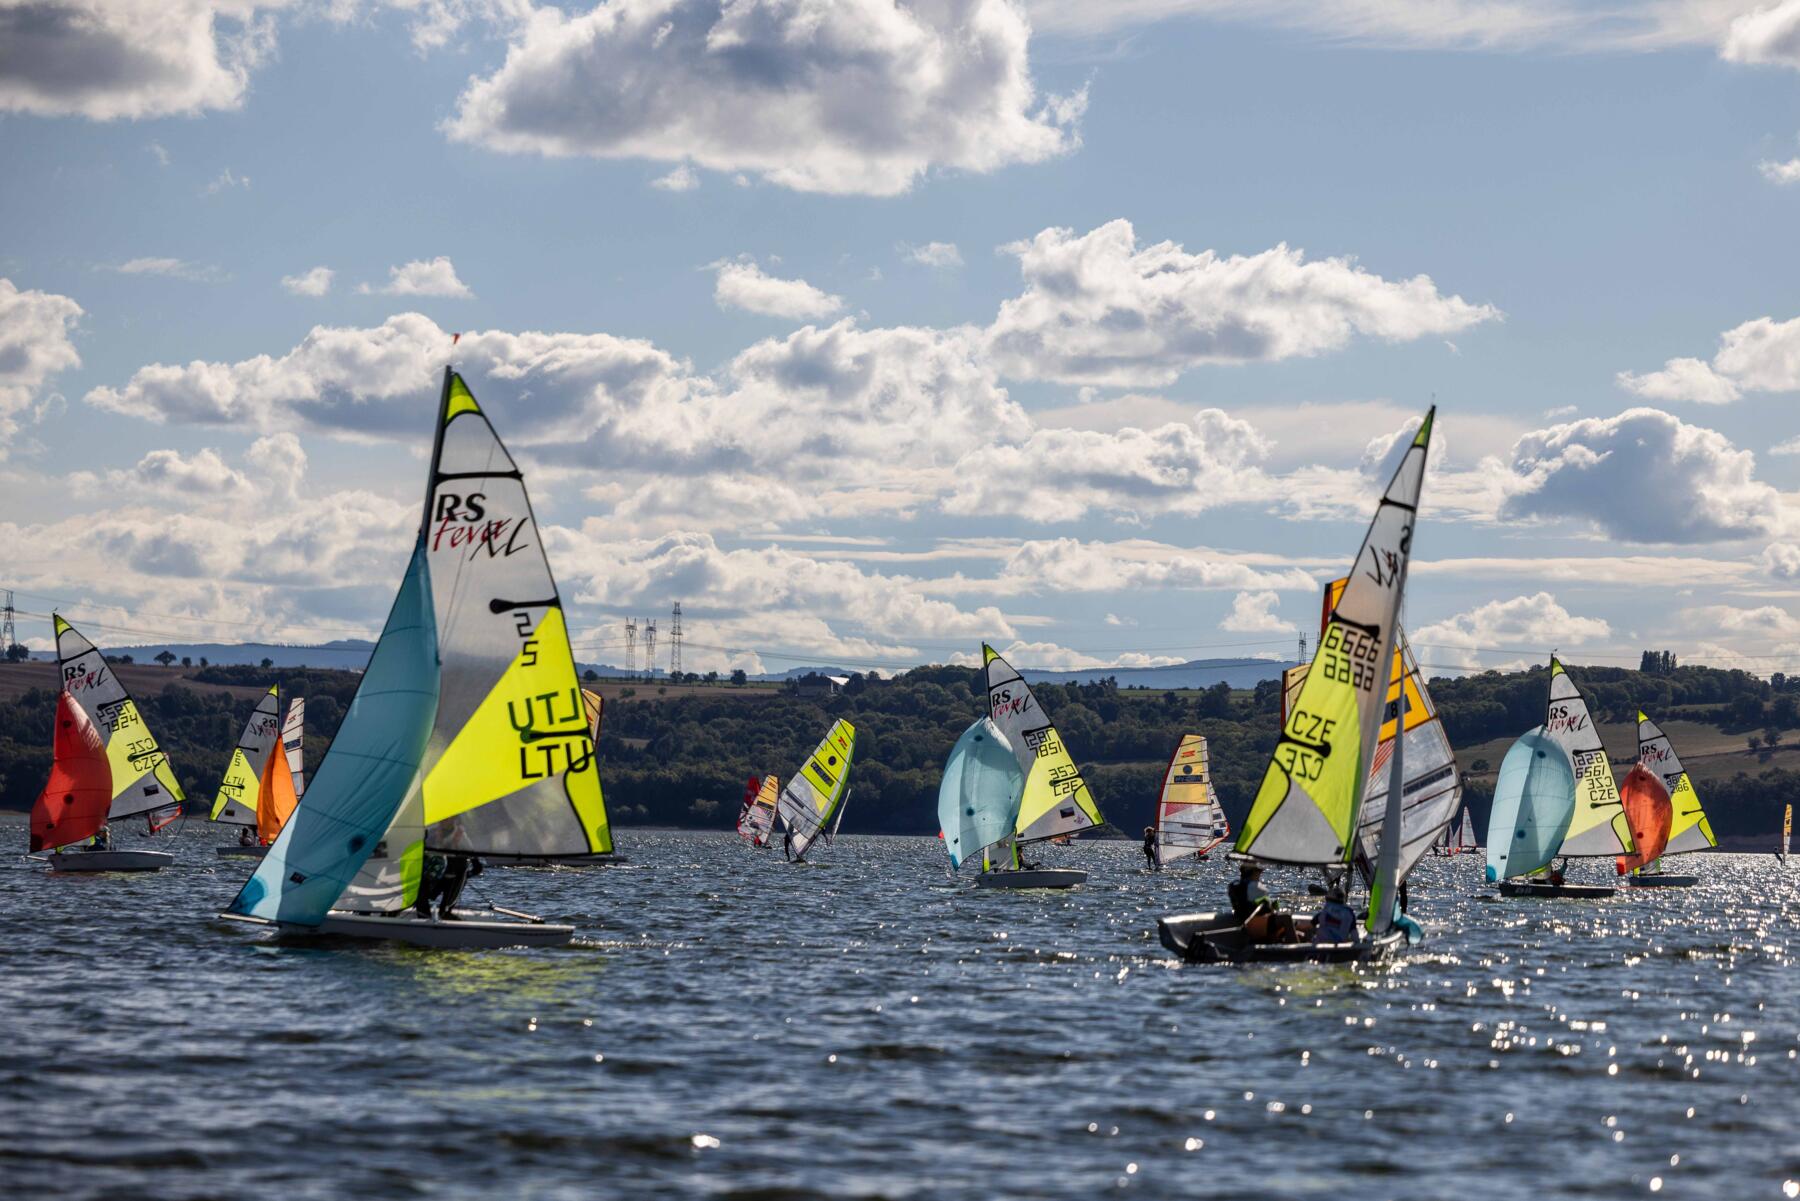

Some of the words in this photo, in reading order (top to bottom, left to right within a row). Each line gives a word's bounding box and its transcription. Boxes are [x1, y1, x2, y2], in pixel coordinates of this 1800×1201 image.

[436, 492, 486, 522] RS
[521, 640, 539, 666] 5
[1325, 626, 1382, 663] 6666
[64, 662, 86, 681] RS
[992, 689, 1011, 708] RS
[1550, 706, 1568, 720] RS
[101, 713, 139, 734] 7924
[1292, 710, 1336, 742] CZE
[1029, 740, 1062, 759] 7851
[1641, 744, 1657, 755] RS
[133, 754, 157, 772] CZE
[520, 740, 589, 779] LTU
[1576, 765, 1605, 779] 6561
[1589, 788, 1616, 801] CZE
